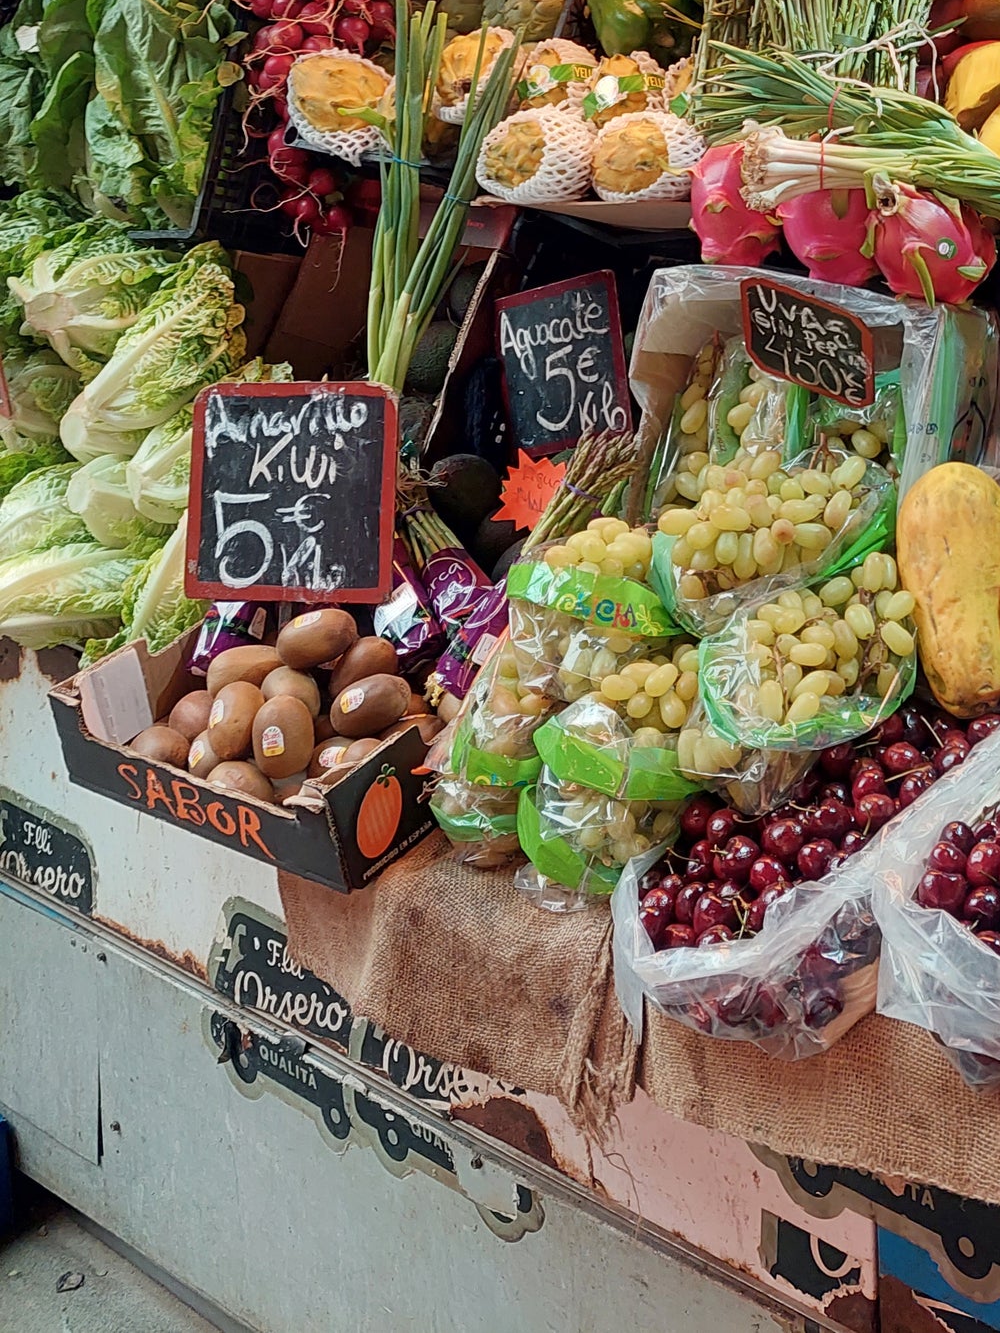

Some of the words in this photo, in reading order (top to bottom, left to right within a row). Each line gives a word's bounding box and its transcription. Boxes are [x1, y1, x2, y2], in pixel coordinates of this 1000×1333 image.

[536, 344, 577, 432] 5
[213, 489, 275, 589] 5
[275, 493, 332, 534] €
[116, 762, 277, 861] SABOR
[258, 1044, 318, 1091] QUALITÀ
